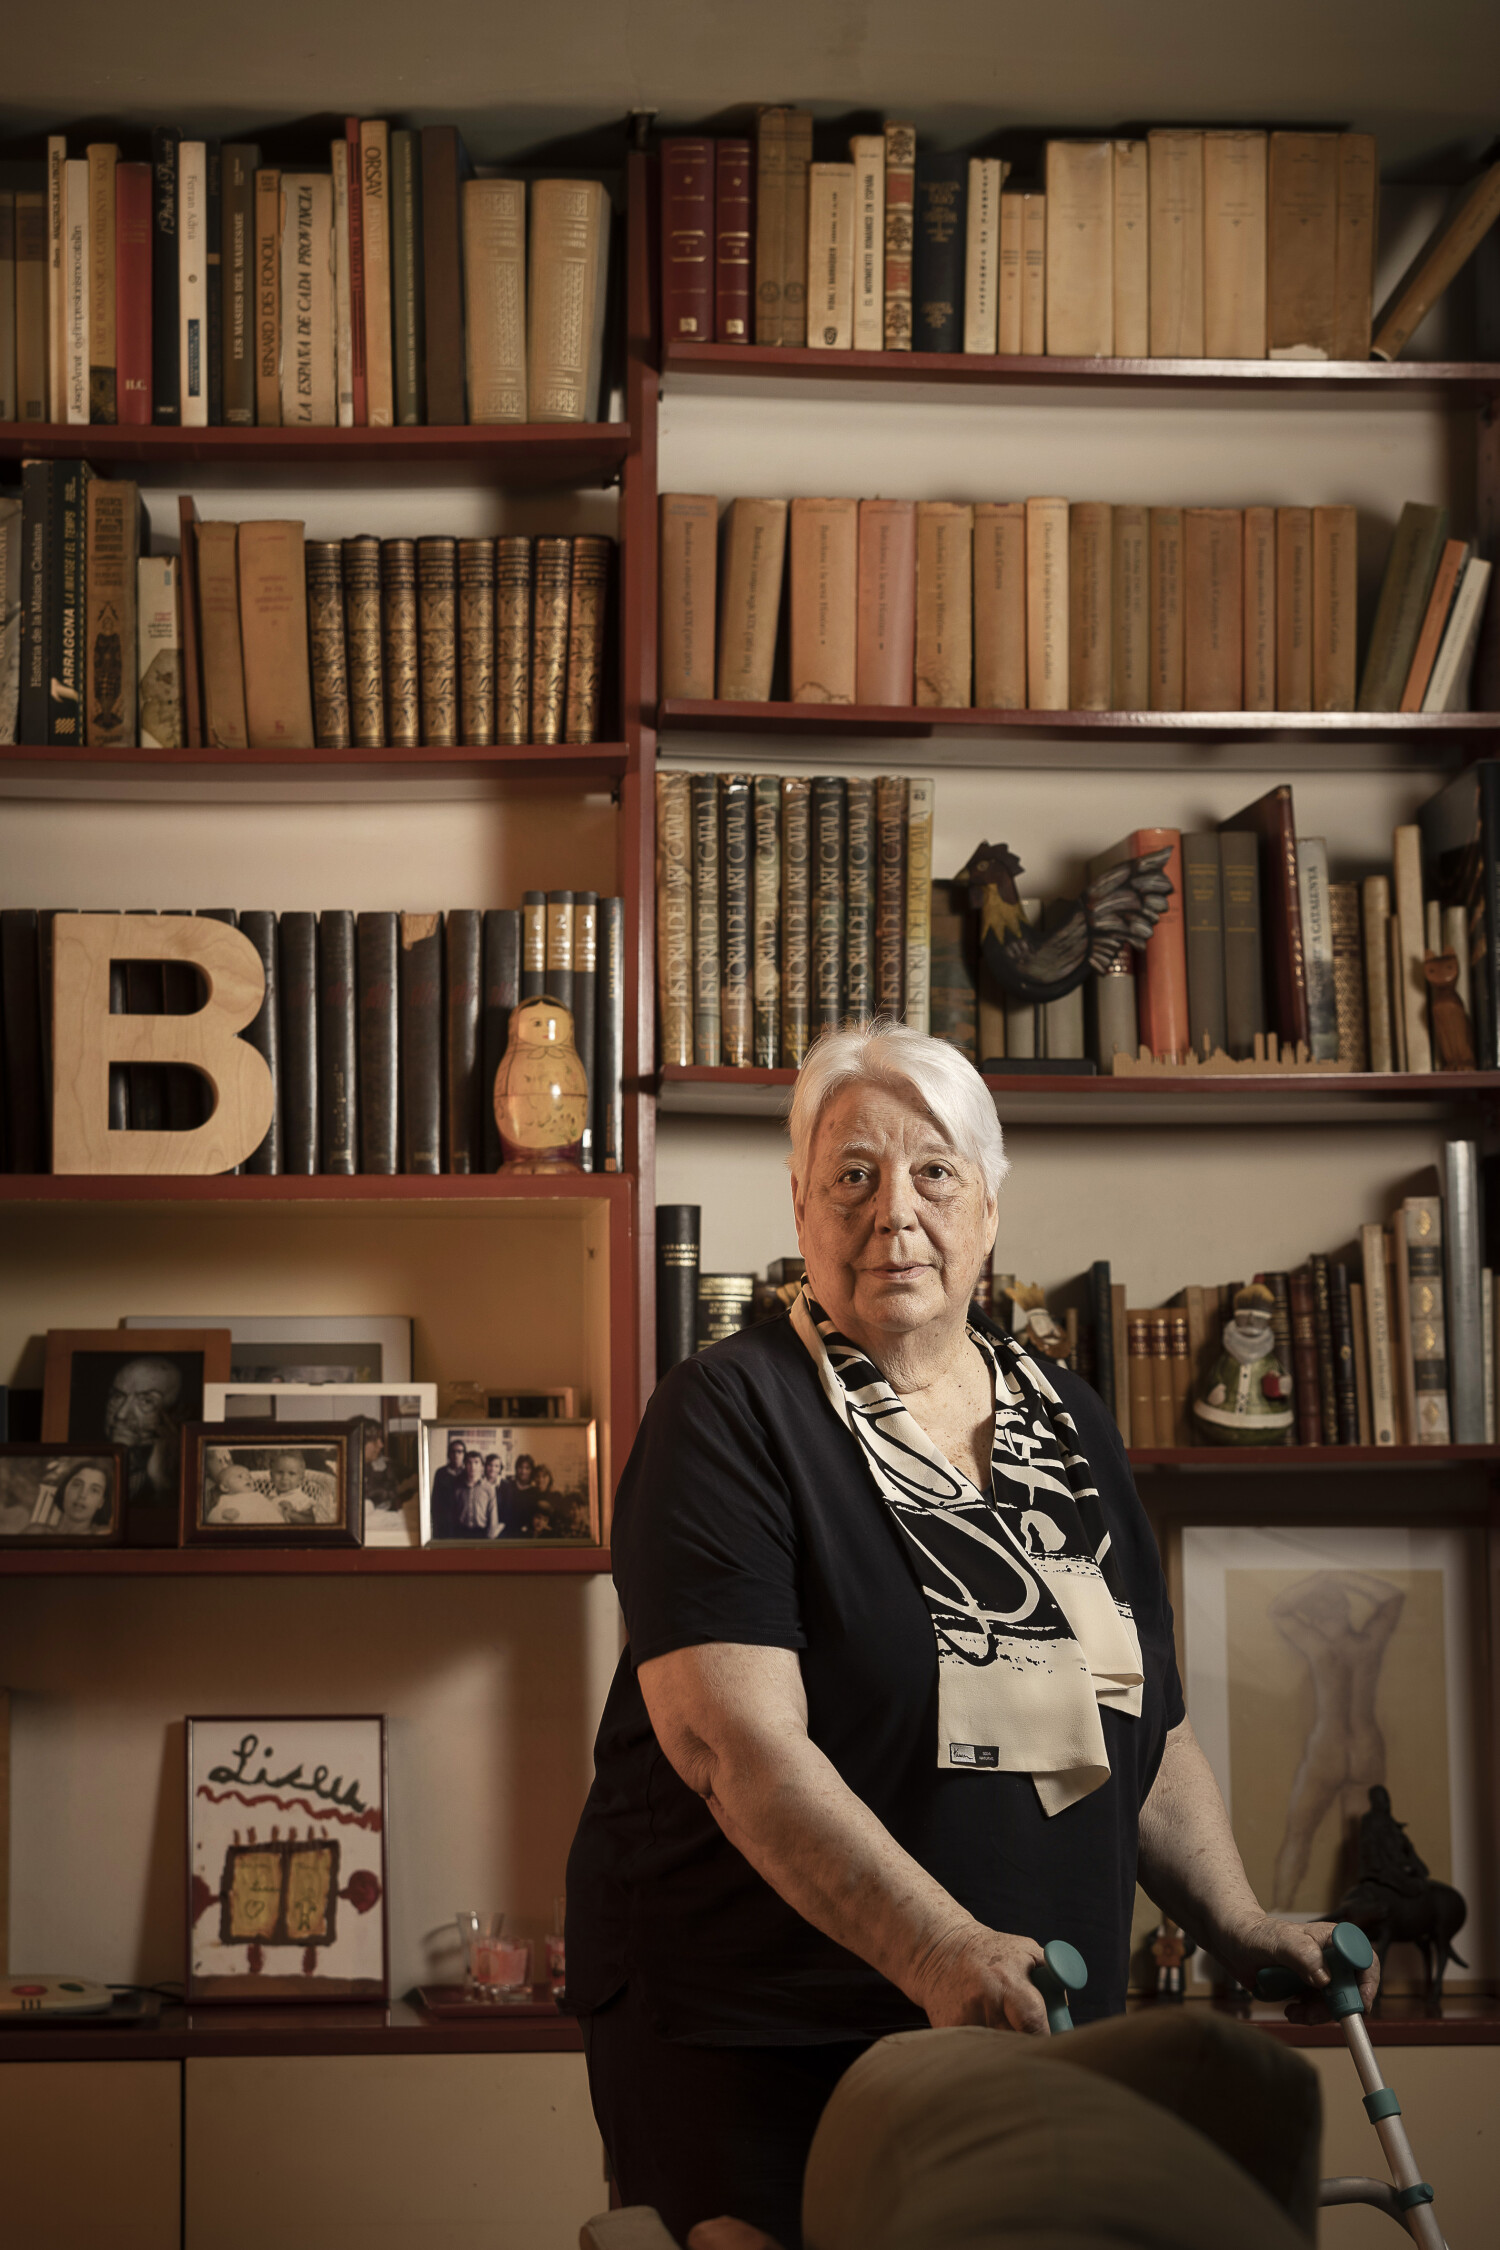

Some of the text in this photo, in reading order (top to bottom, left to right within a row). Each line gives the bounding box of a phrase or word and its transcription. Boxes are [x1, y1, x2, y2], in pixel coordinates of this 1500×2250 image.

[364, 146, 383, 199] ORSAY
[187, 174, 198, 209] Ferran
[296, 185, 312, 266] PROVINCIA
[261, 231, 275, 287] FONOLL
[233, 212, 244, 359] LES MASIES DEL MARESME
[297, 272, 312, 312] CADA
[262, 290, 275, 316] DES
[297, 315, 312, 336] DE
[72, 355, 82, 383] Amat
[71, 382, 85, 414] Josep
[298, 403, 312, 422] LA
[30, 522, 43, 571] Catalana
[31, 614, 42, 626] la
[31, 627, 43, 643] de
[50, 608, 79, 703] TARRAGONA
[666, 904, 688, 931] DE
[696, 906, 719, 931] DE
[725, 907, 746, 933] DE
[756, 909, 777, 935] DE
[786, 907, 808, 932] DE
[818, 906, 840, 933] DE
[846, 909, 869, 935] DE
[881, 906, 902, 933] DE
[905, 914, 928, 942] DE
[52, 913, 274, 1176] B
[207, 1733, 367, 1813] Liceu
